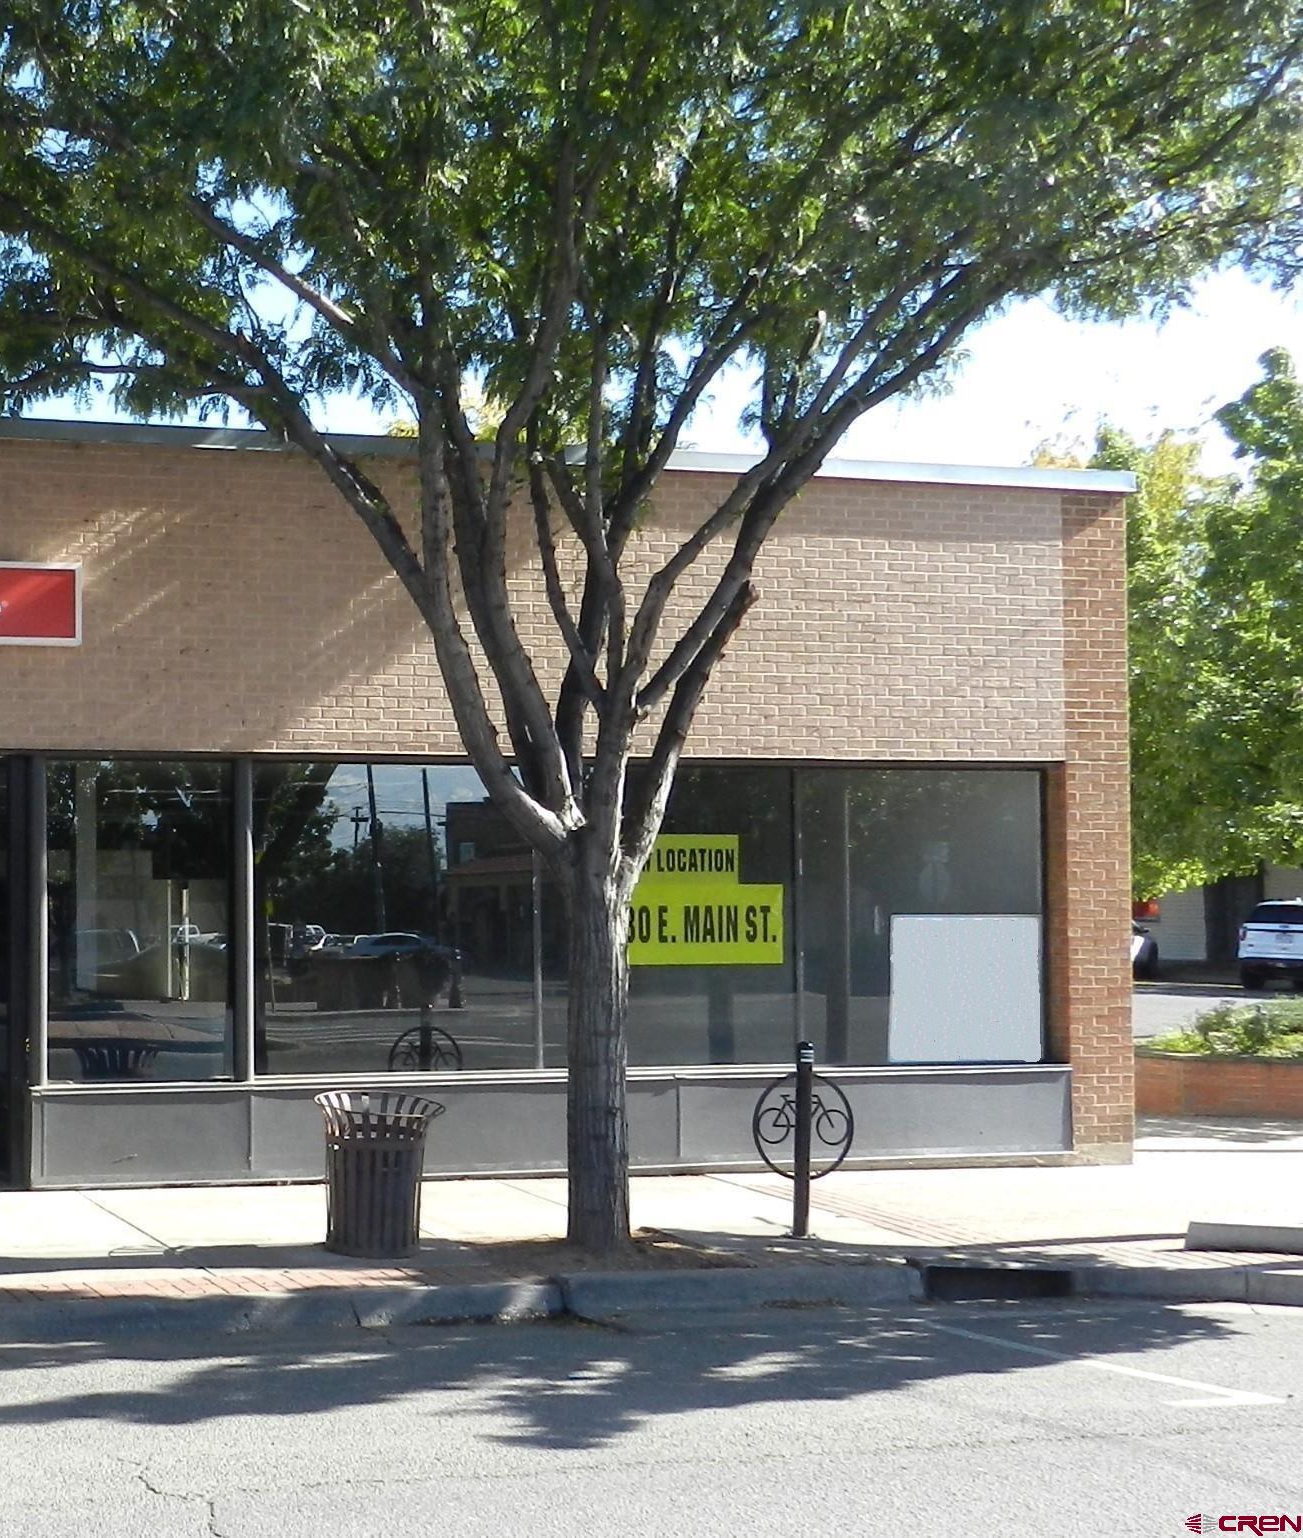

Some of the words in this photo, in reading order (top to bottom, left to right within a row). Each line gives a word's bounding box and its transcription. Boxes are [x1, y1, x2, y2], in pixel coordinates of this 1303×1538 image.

[657, 848, 735, 872] LOCATION
[658, 905, 676, 943] E.
[684, 905, 739, 943] MAIN
[745, 905, 777, 943] ST.
